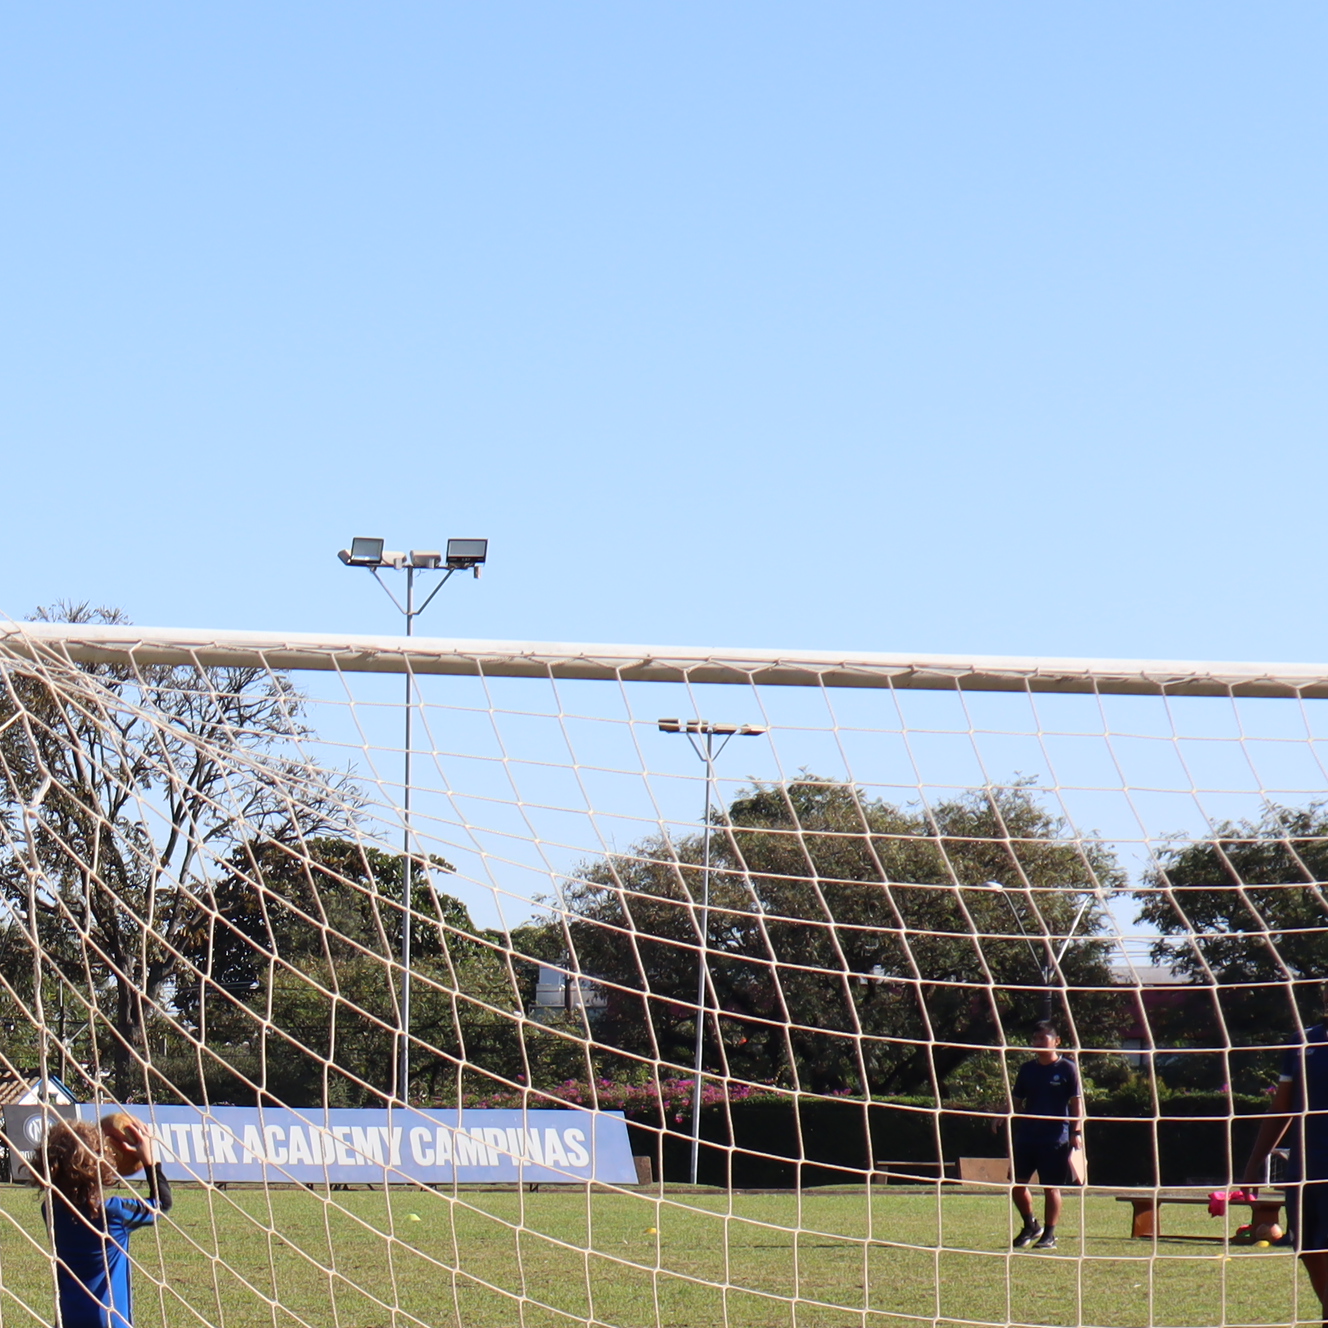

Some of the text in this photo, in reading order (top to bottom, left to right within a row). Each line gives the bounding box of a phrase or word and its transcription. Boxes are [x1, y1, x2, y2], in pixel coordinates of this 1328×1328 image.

[139, 1122, 590, 1168] NTER ACADEMY CAMPINAS
